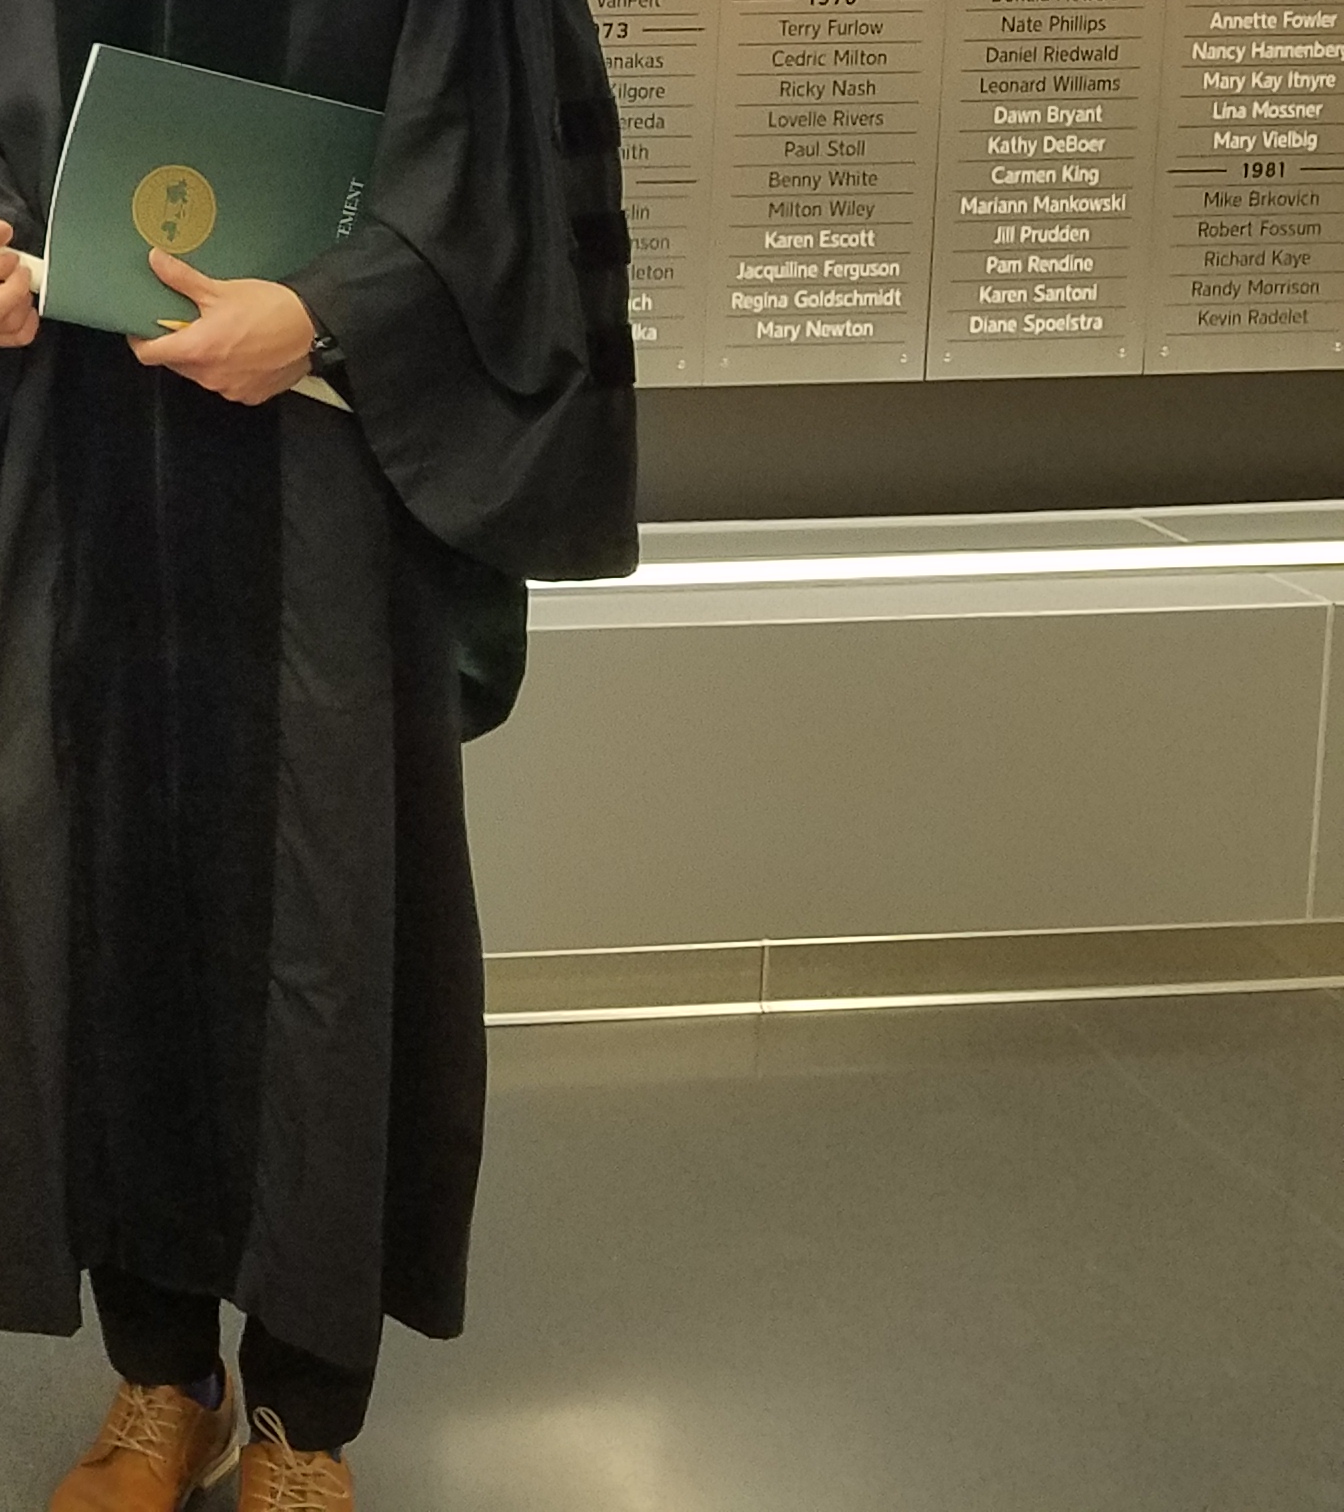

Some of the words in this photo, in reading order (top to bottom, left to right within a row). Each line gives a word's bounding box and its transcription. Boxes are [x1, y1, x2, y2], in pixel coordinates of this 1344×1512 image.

[778, 19, 822, 41] Terry
[827, 18, 884, 37] Furlow
[993, 105, 1042, 125] Dawn
[1046, 104, 1103, 128] Bryant
[1243, 161, 1285, 179] 1981
[764, 230, 814, 249] Karen
[819, 228, 875, 248] Escott
[993, 225, 1016, 245] Jill
[1019, 223, 1090, 244] Prudden
[1197, 220, 1253, 239] Robert
[1259, 219, 1322, 237] Fossum
[756, 320, 802, 343] Mary
[805, 319, 874, 338] Newton
[969, 315, 1018, 334] Diane
